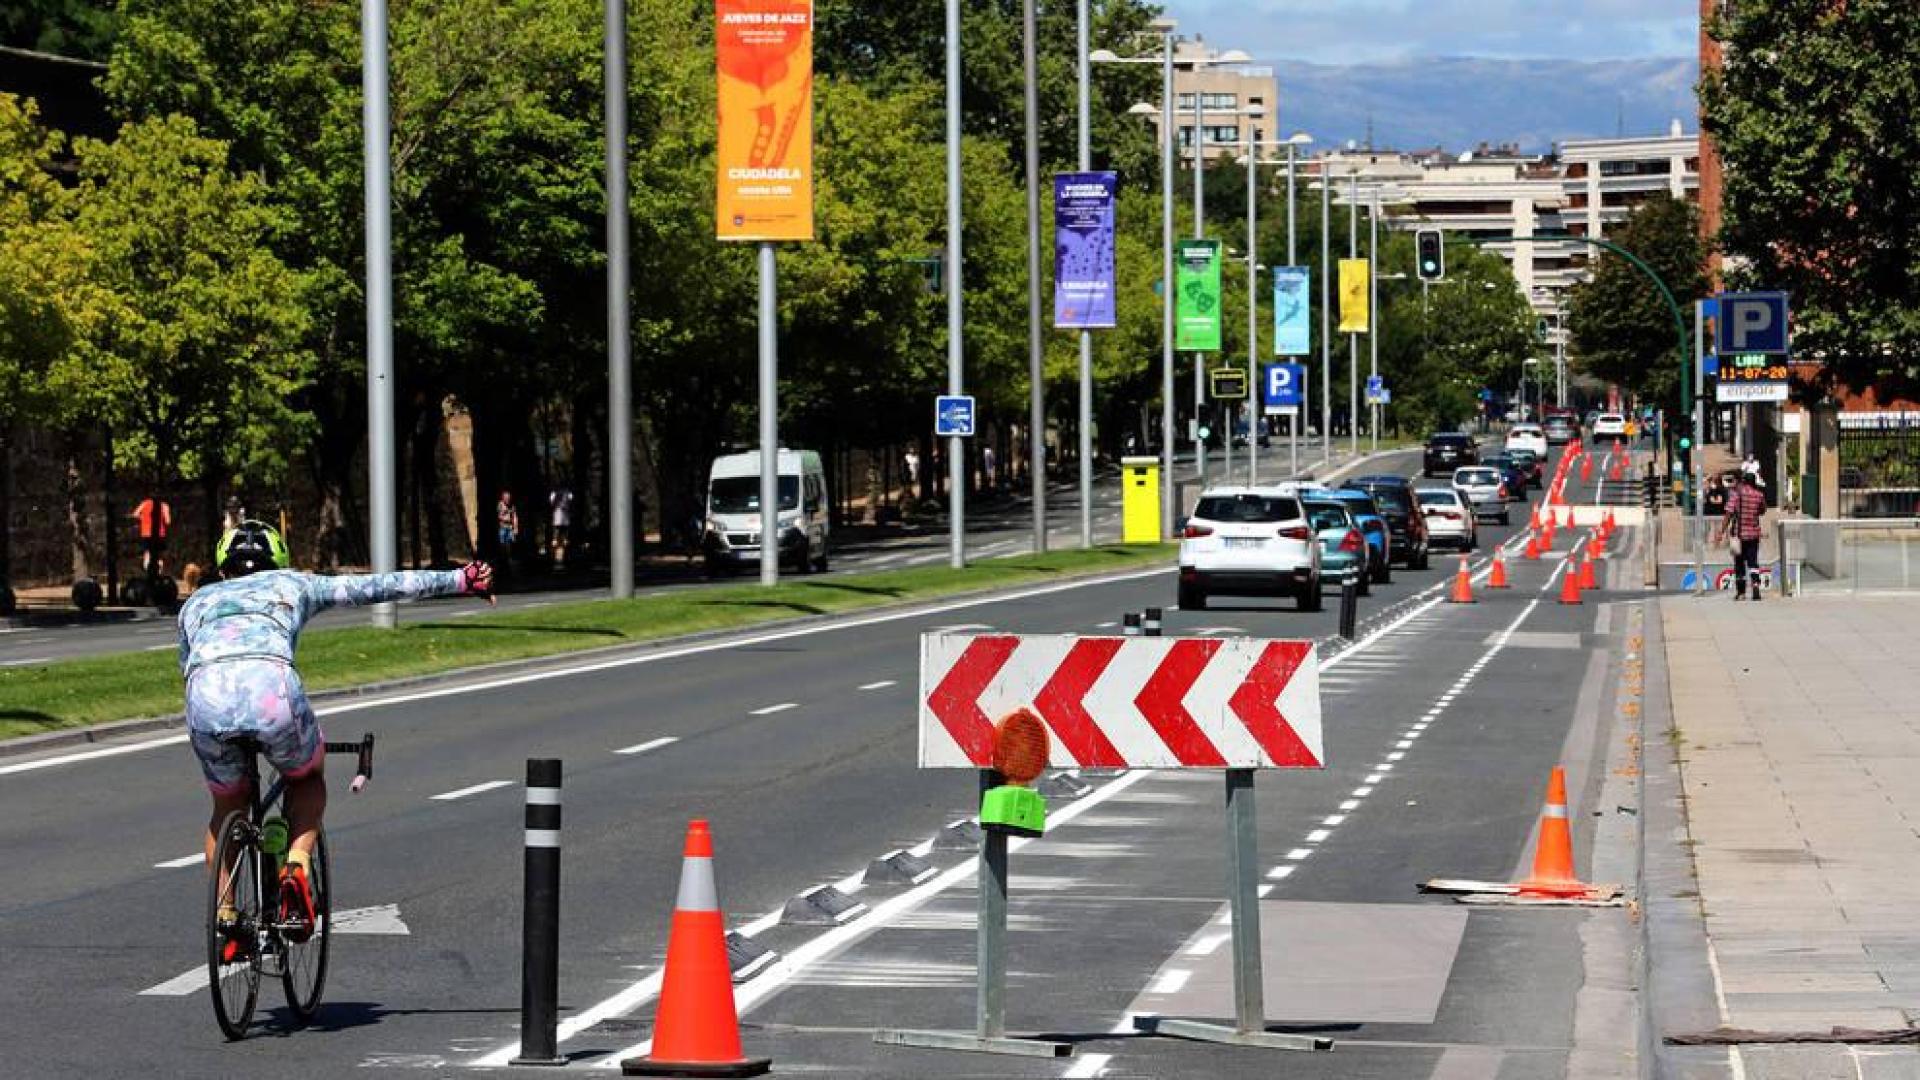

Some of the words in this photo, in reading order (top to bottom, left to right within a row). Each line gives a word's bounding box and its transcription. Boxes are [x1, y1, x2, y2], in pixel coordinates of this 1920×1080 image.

[721, 13, 762, 24] JUEVES
[763, 13, 778, 24] DE
[780, 13, 806, 24] JAZZ
[728, 168, 801, 179] CIUDADELA
[1733, 301, 1771, 347] P
[1720, 366, 1787, 379] 11-07-20
[1269, 368, 1290, 396] P
